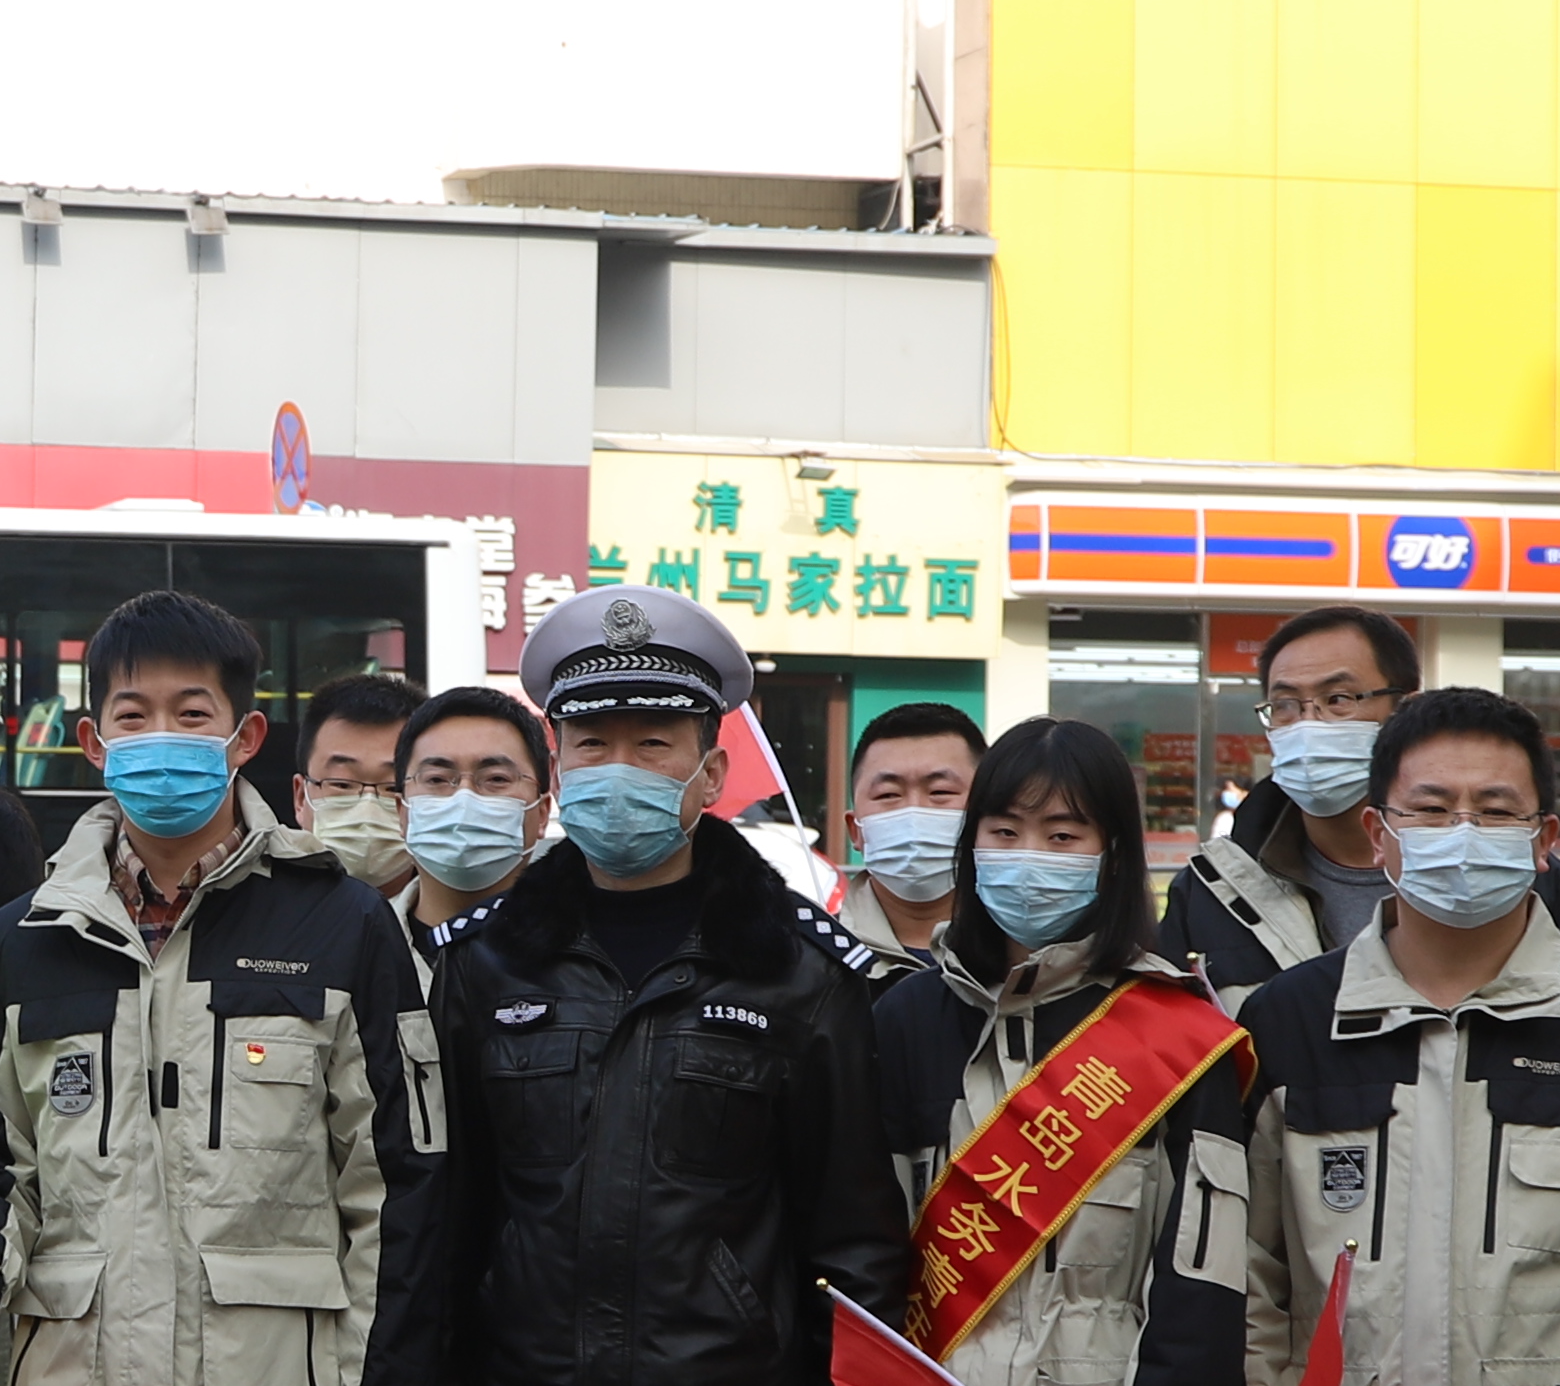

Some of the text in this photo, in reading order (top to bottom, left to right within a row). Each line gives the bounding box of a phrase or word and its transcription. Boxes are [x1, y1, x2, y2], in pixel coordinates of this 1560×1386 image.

[1390, 533, 1470, 571] 可好
[588, 544, 980, 622] 兰州马家拉面
[702, 1004, 769, 1030] 113869
